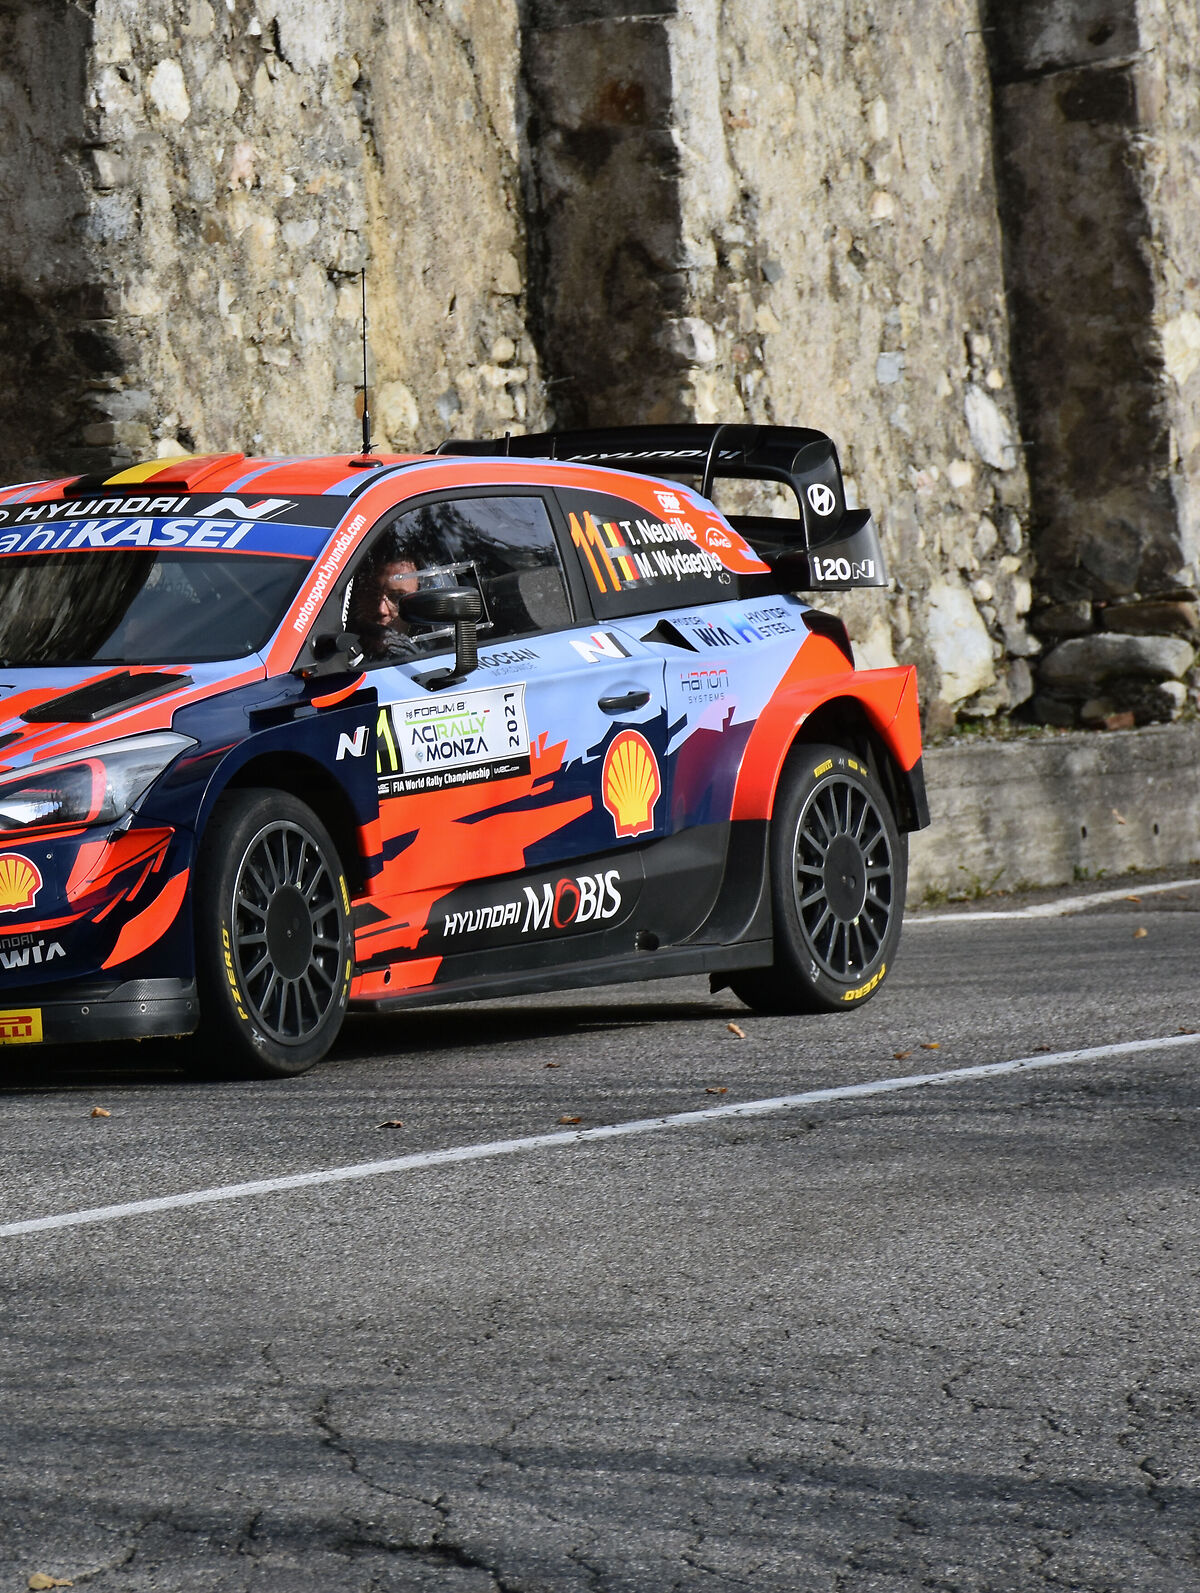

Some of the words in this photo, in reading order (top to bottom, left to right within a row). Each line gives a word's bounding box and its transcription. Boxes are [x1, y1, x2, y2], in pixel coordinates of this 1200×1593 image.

[15, 497, 190, 522] HYUNDAI
[619, 521, 640, 546] T.
[636, 517, 697, 544] Neuville
[568, 510, 622, 593] 11
[293, 514, 367, 633] motorsport.hyundai.com
[634, 553, 658, 579] M.
[652, 549, 722, 582] Wydaeghe
[814, 556, 851, 581] i20
[744, 607, 792, 625] HYUNDAI
[758, 622, 796, 638] STEEL
[414, 703, 455, 718] FORUM
[456, 702, 465, 711] 8
[688, 693, 726, 704] SYSTEMS
[504, 692, 520, 748] 2021
[426, 736, 488, 762] MONZA
[393, 781, 405, 792] FIA
[405, 777, 425, 791] World
[426, 774, 443, 788] Rally
[444, 767, 491, 784] Championship
[443, 902, 521, 936] HYUNDAI
[521, 870, 622, 933] MOBIS
